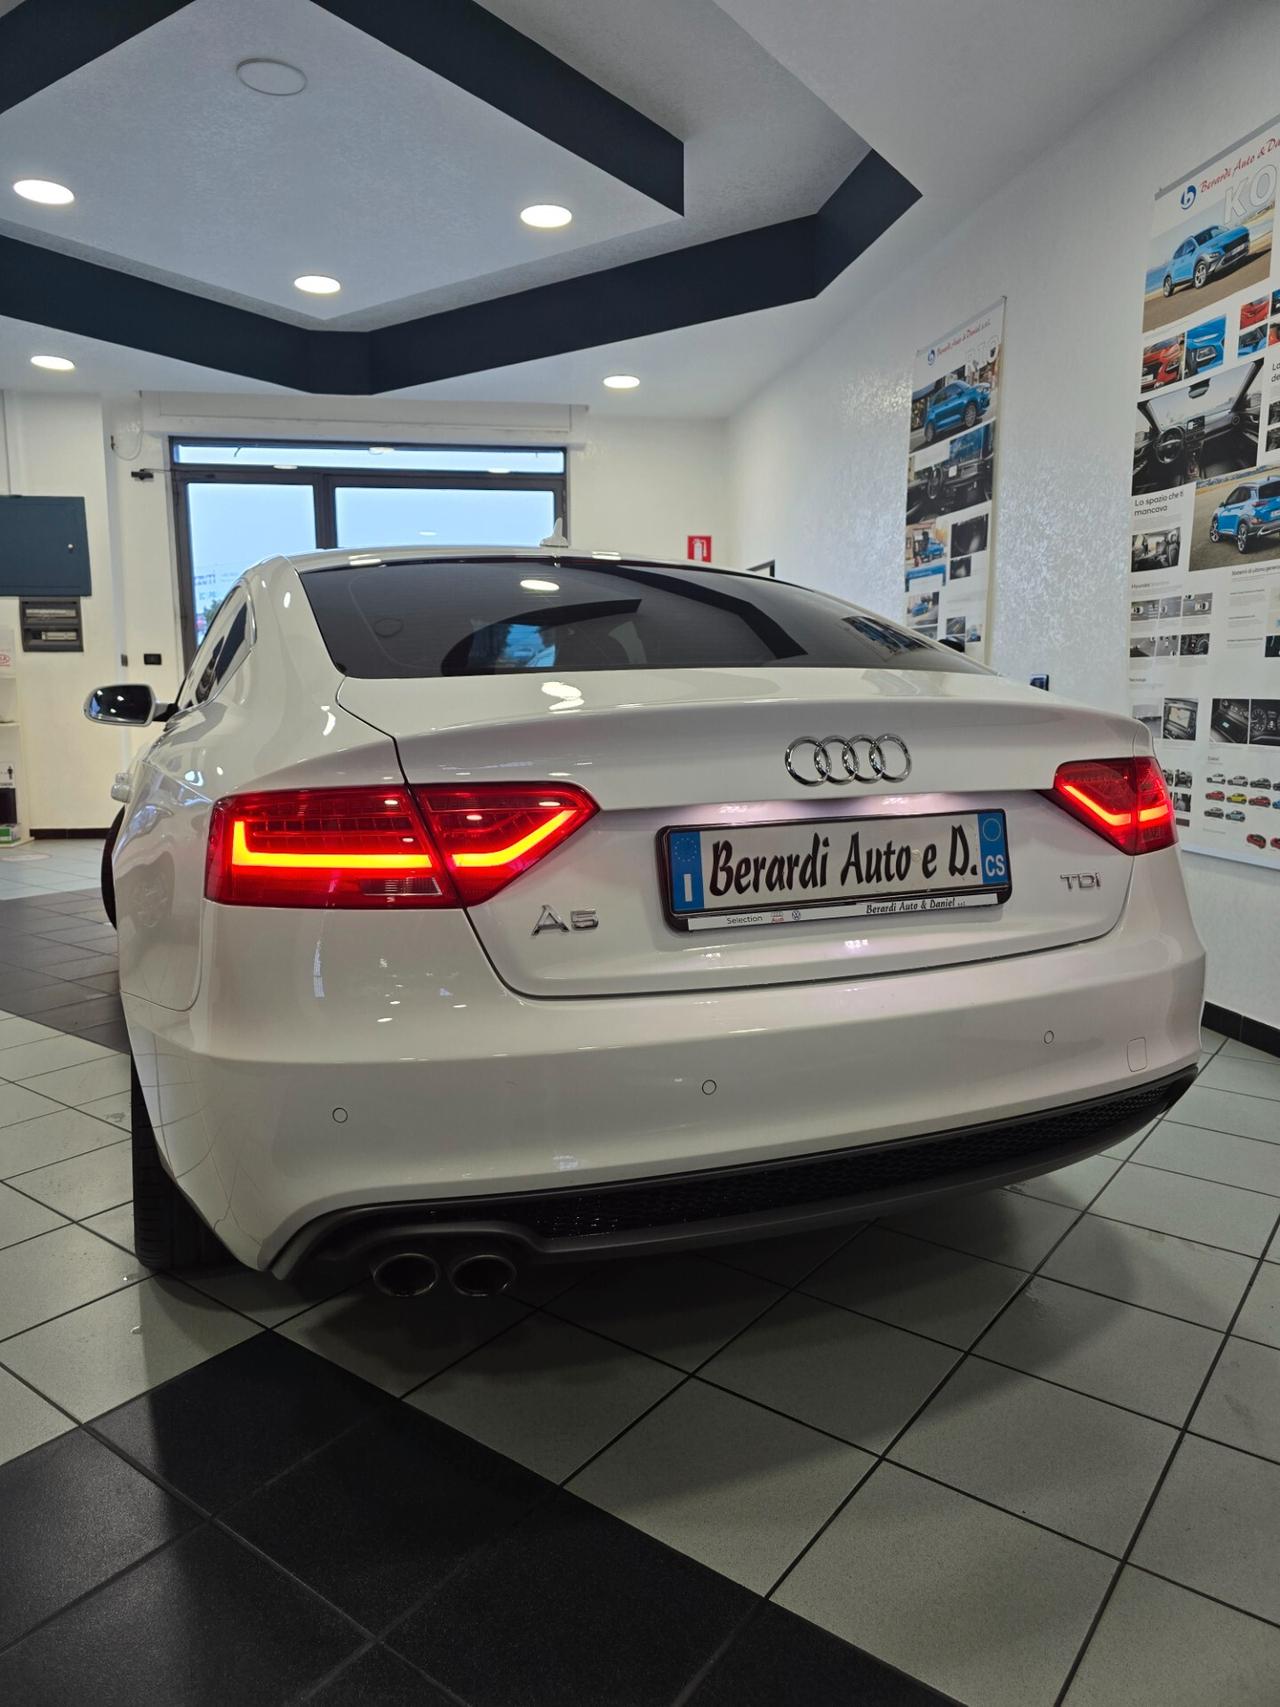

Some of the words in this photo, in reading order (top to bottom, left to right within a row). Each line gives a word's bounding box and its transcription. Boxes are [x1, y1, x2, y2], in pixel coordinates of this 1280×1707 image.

[1146, 494, 1168, 505] spazio
[1134, 504, 1168, 517] mancava
[709, 831, 830, 897] Berardi
[840, 831, 911, 886] Auto
[922, 843, 937, 879] e
[948, 824, 978, 877] D.
[984, 854, 1005, 877] CS
[683, 873, 693, 902] I
[866, 901, 897, 914] Berardi
[899, 902, 918, 911] Auto
[920, 900, 927, 909] &
[930, 898, 956, 909] Daniel
[531, 904, 599, 937] A5
[726, 914, 763, 925] Selection
